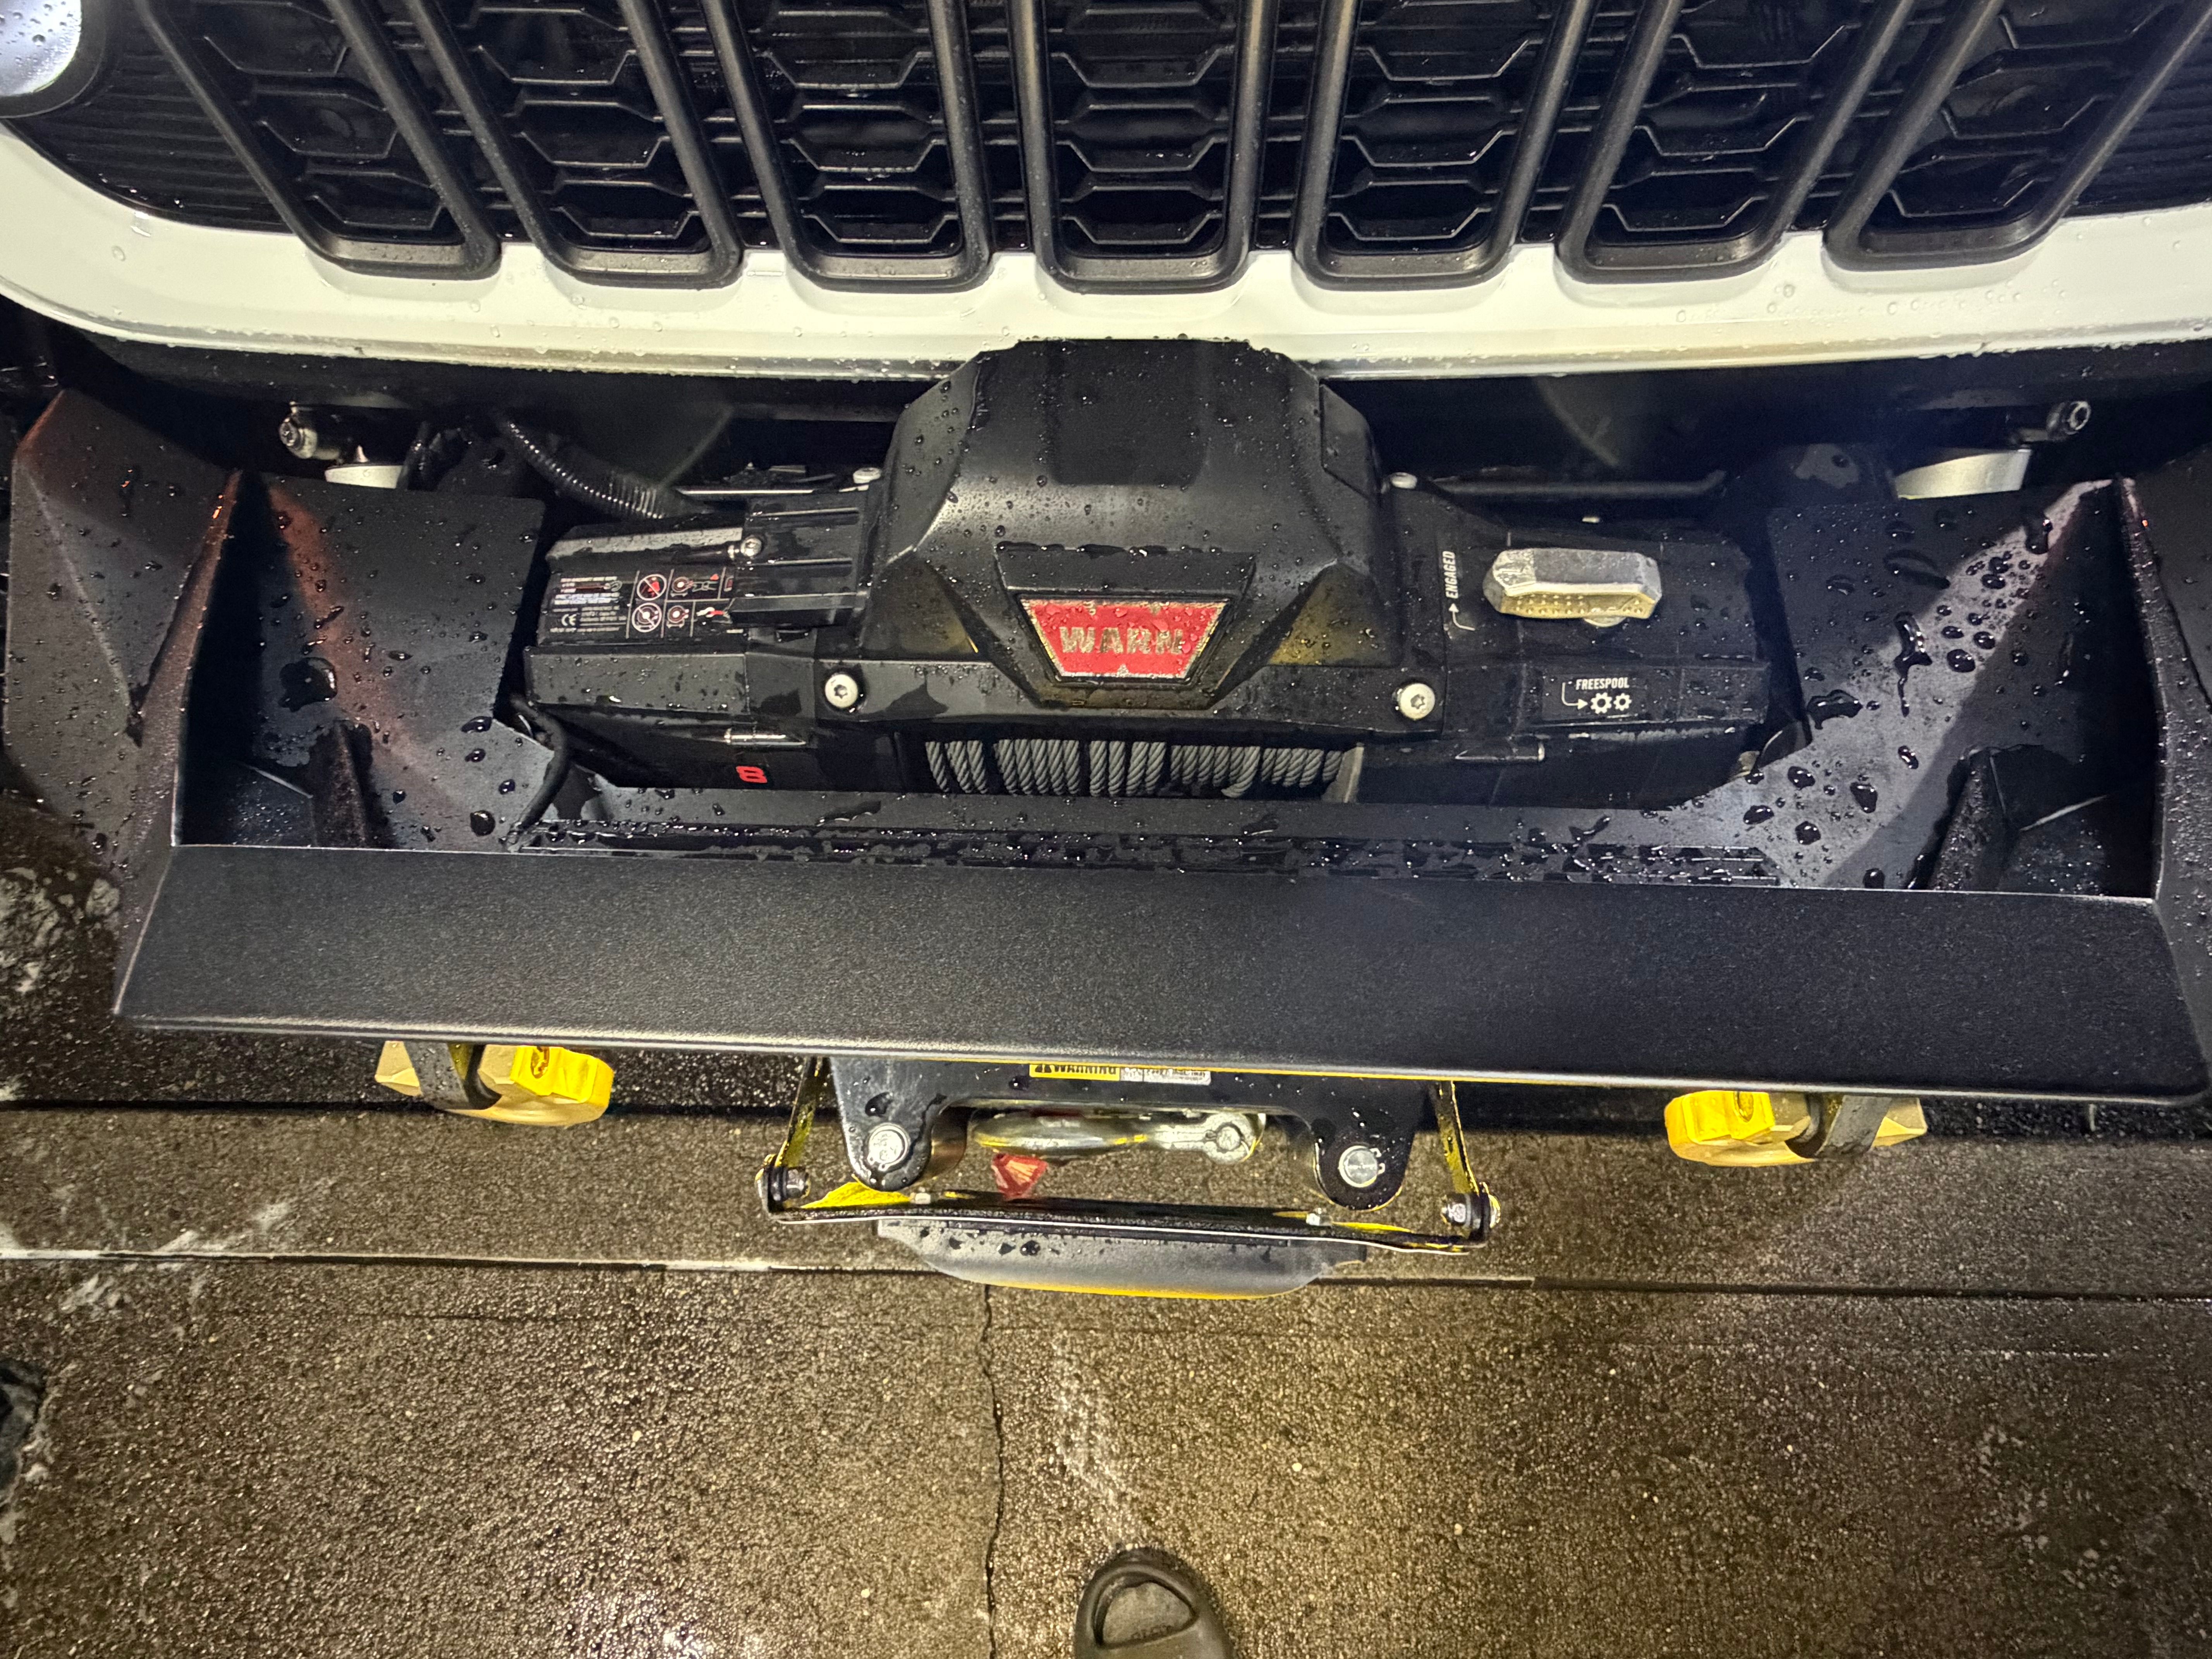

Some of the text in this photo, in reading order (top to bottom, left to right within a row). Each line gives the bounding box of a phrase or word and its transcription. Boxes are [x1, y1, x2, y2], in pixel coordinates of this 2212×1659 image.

[1442, 551, 1458, 599] ENGAGED
[562, 613, 577, 626] CE
[1059, 626, 1183, 655] WARN
[1575, 677, 1630, 690] FREESPOOL
[736, 766, 768, 783] 8
